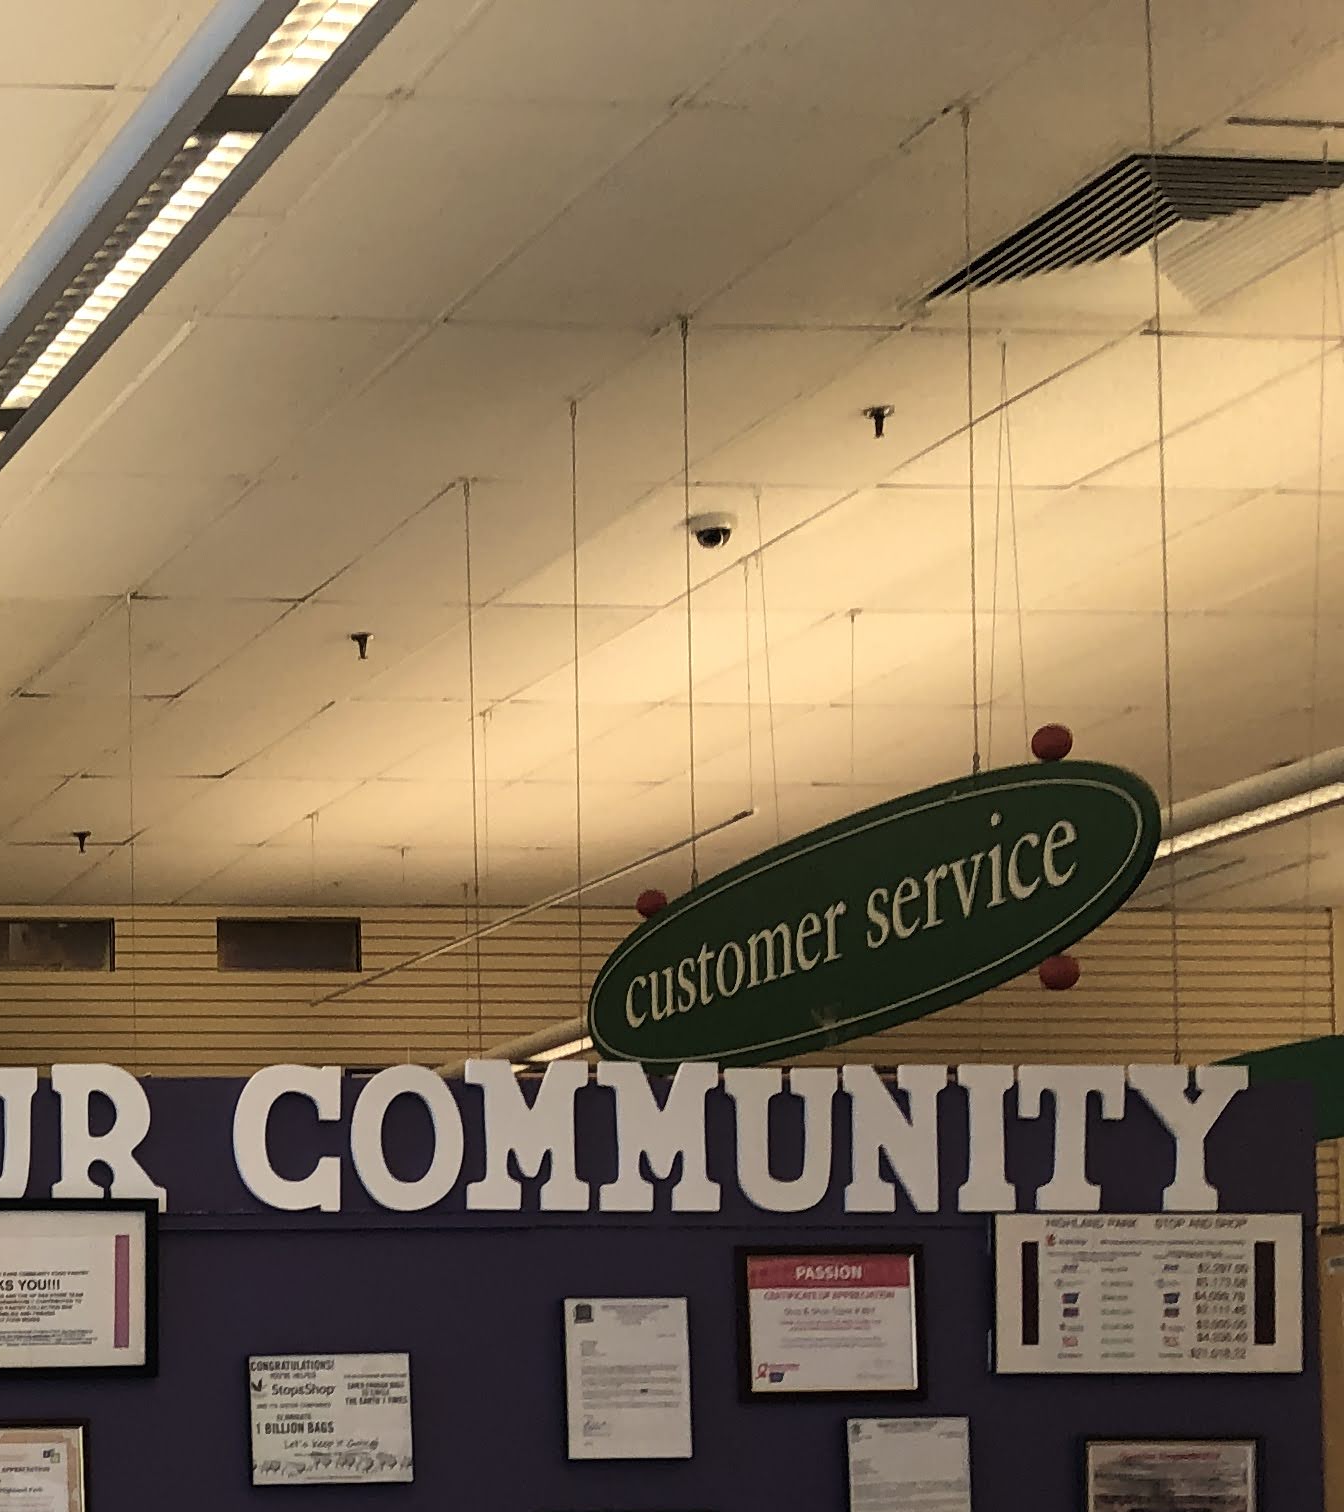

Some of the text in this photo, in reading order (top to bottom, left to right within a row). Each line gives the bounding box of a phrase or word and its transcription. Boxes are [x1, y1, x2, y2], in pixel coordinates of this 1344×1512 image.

[625, 811, 1080, 1029] customer service
[233, 1059, 1250, 1213] COMMUNITY
[794, 1264, 863, 1281] PASSION
[18, 1279, 61, 1291] YOU!!!
[250, 1360, 335, 1372] CONGRATULATIONS!
[264, 1422, 304, 1435] BILLION
[307, 1421, 335, 1434] BAGS
